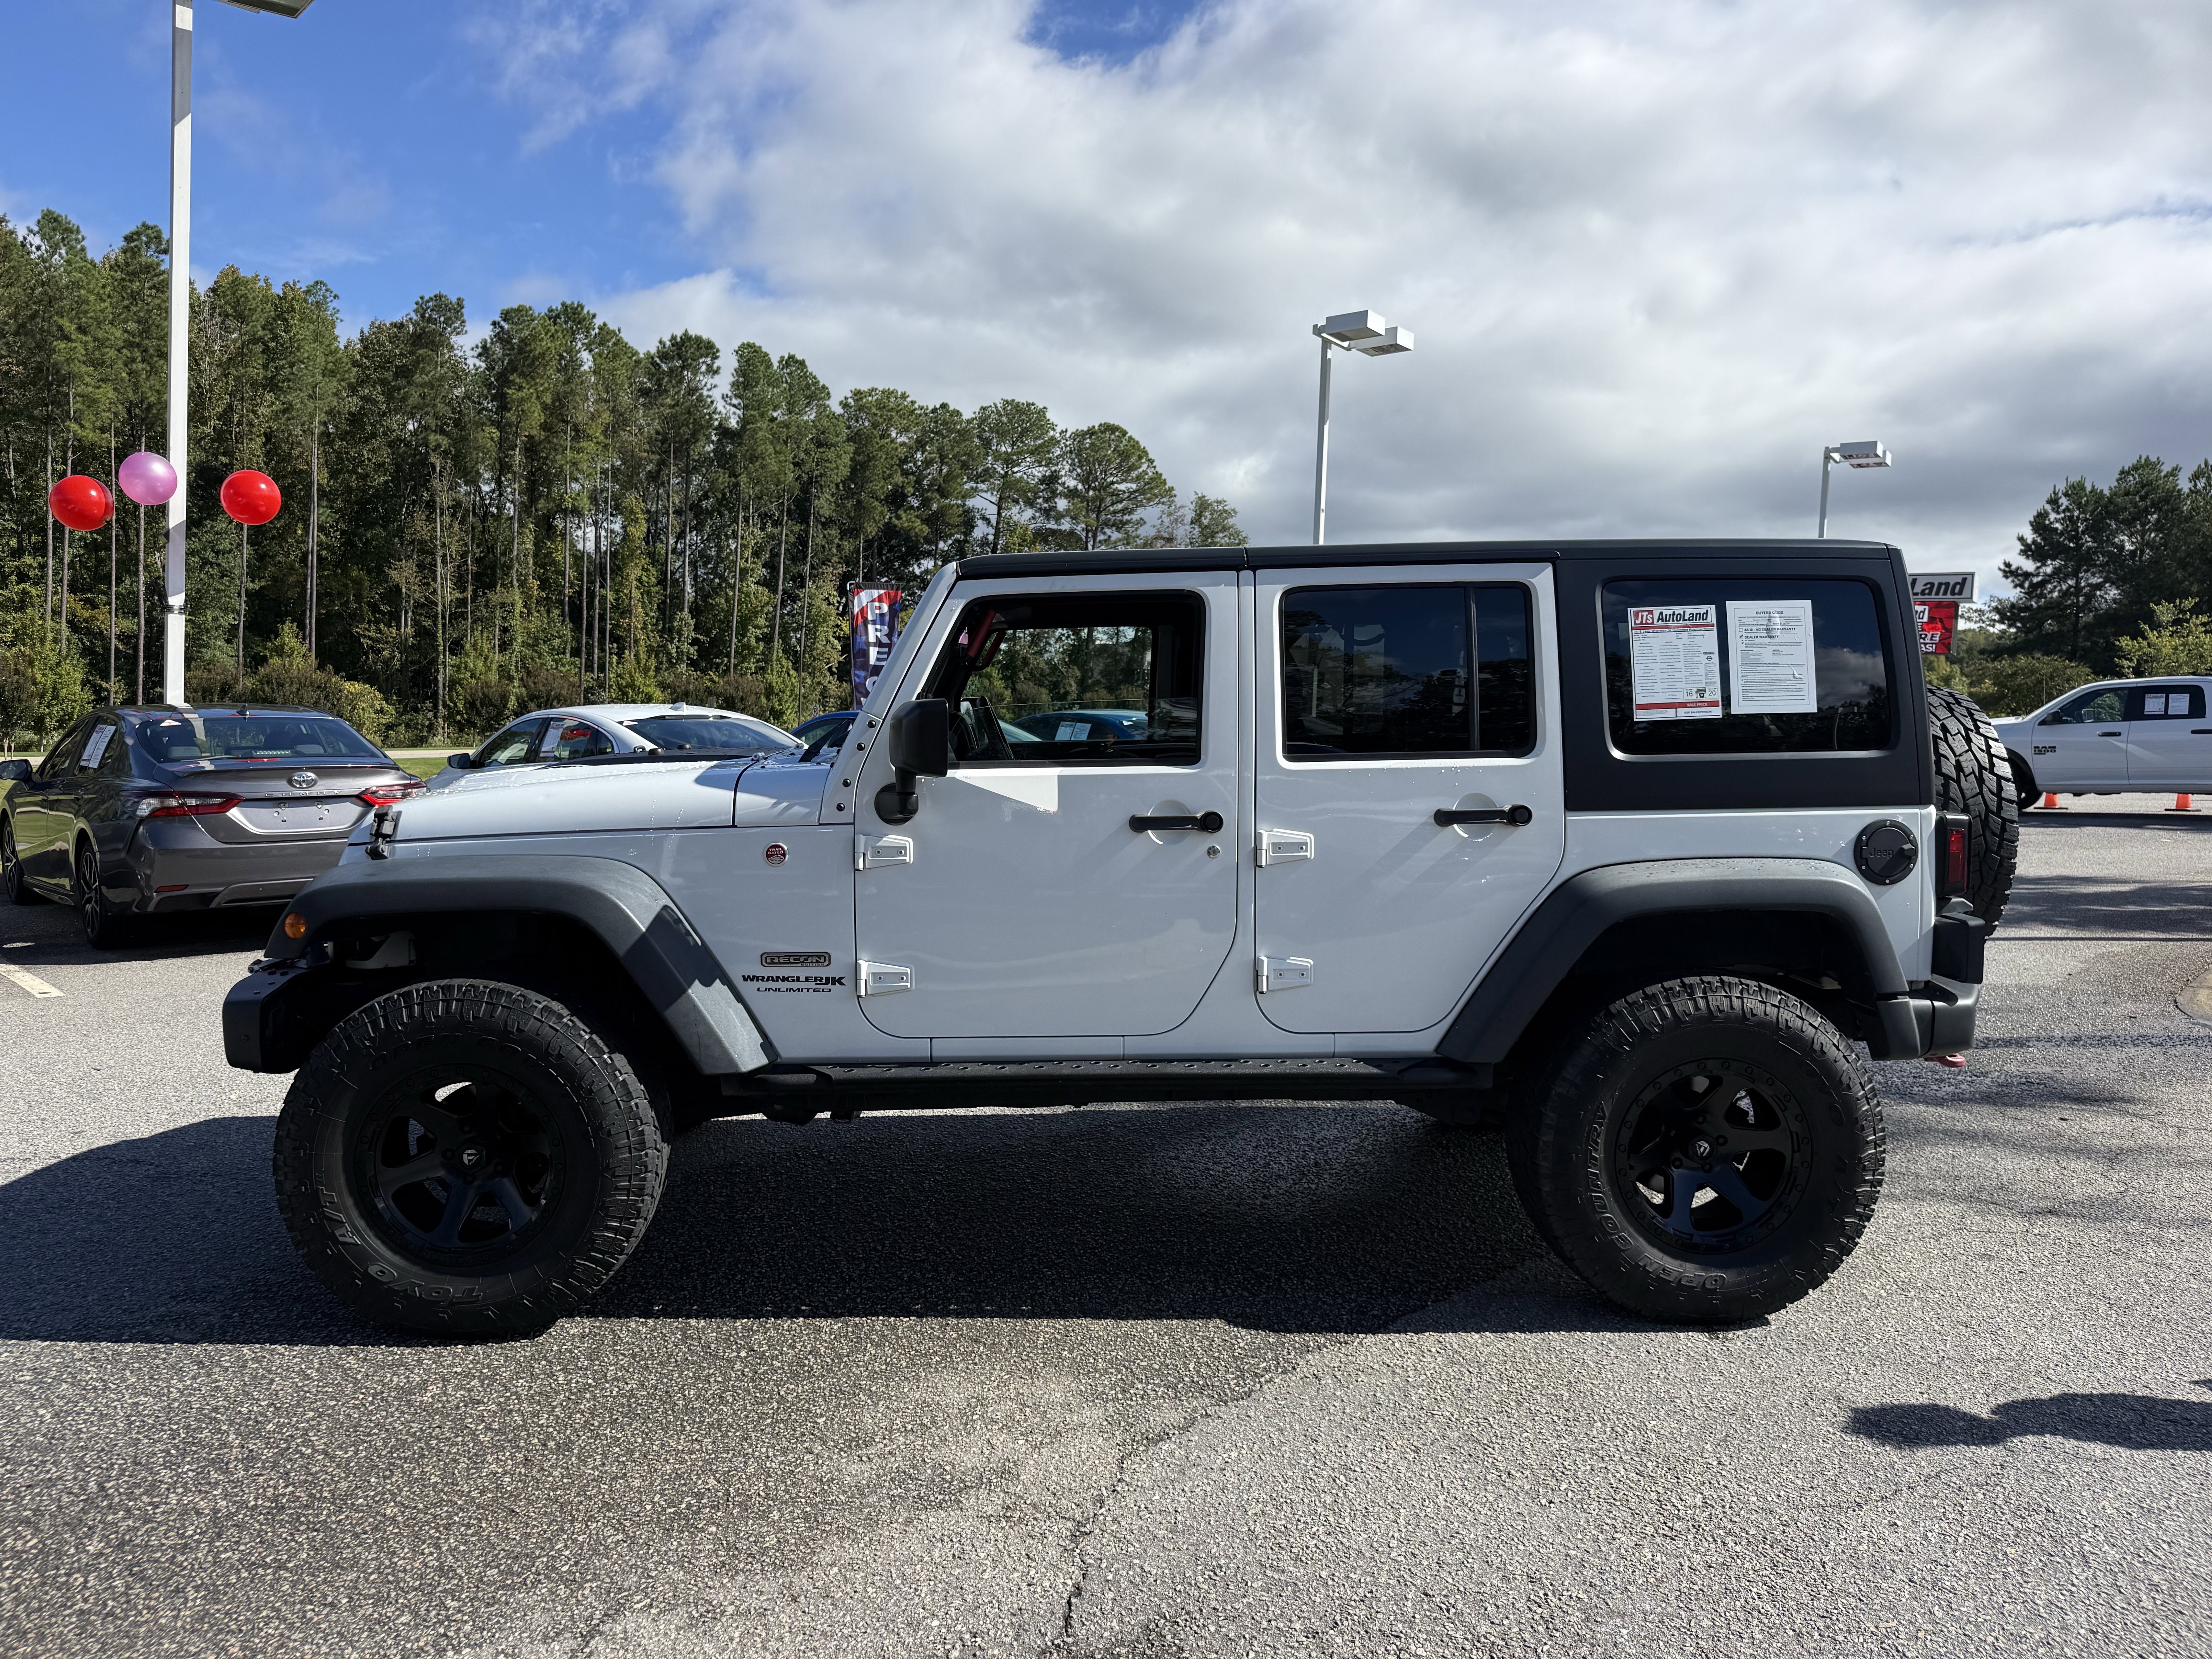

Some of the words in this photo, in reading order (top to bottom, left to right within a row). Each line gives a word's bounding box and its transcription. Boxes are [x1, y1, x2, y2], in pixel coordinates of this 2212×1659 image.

[1635, 612, 1652, 624] JTs
[1656, 610, 1709, 623] AutoLand
[1869, 847, 1893, 859] Jeep
